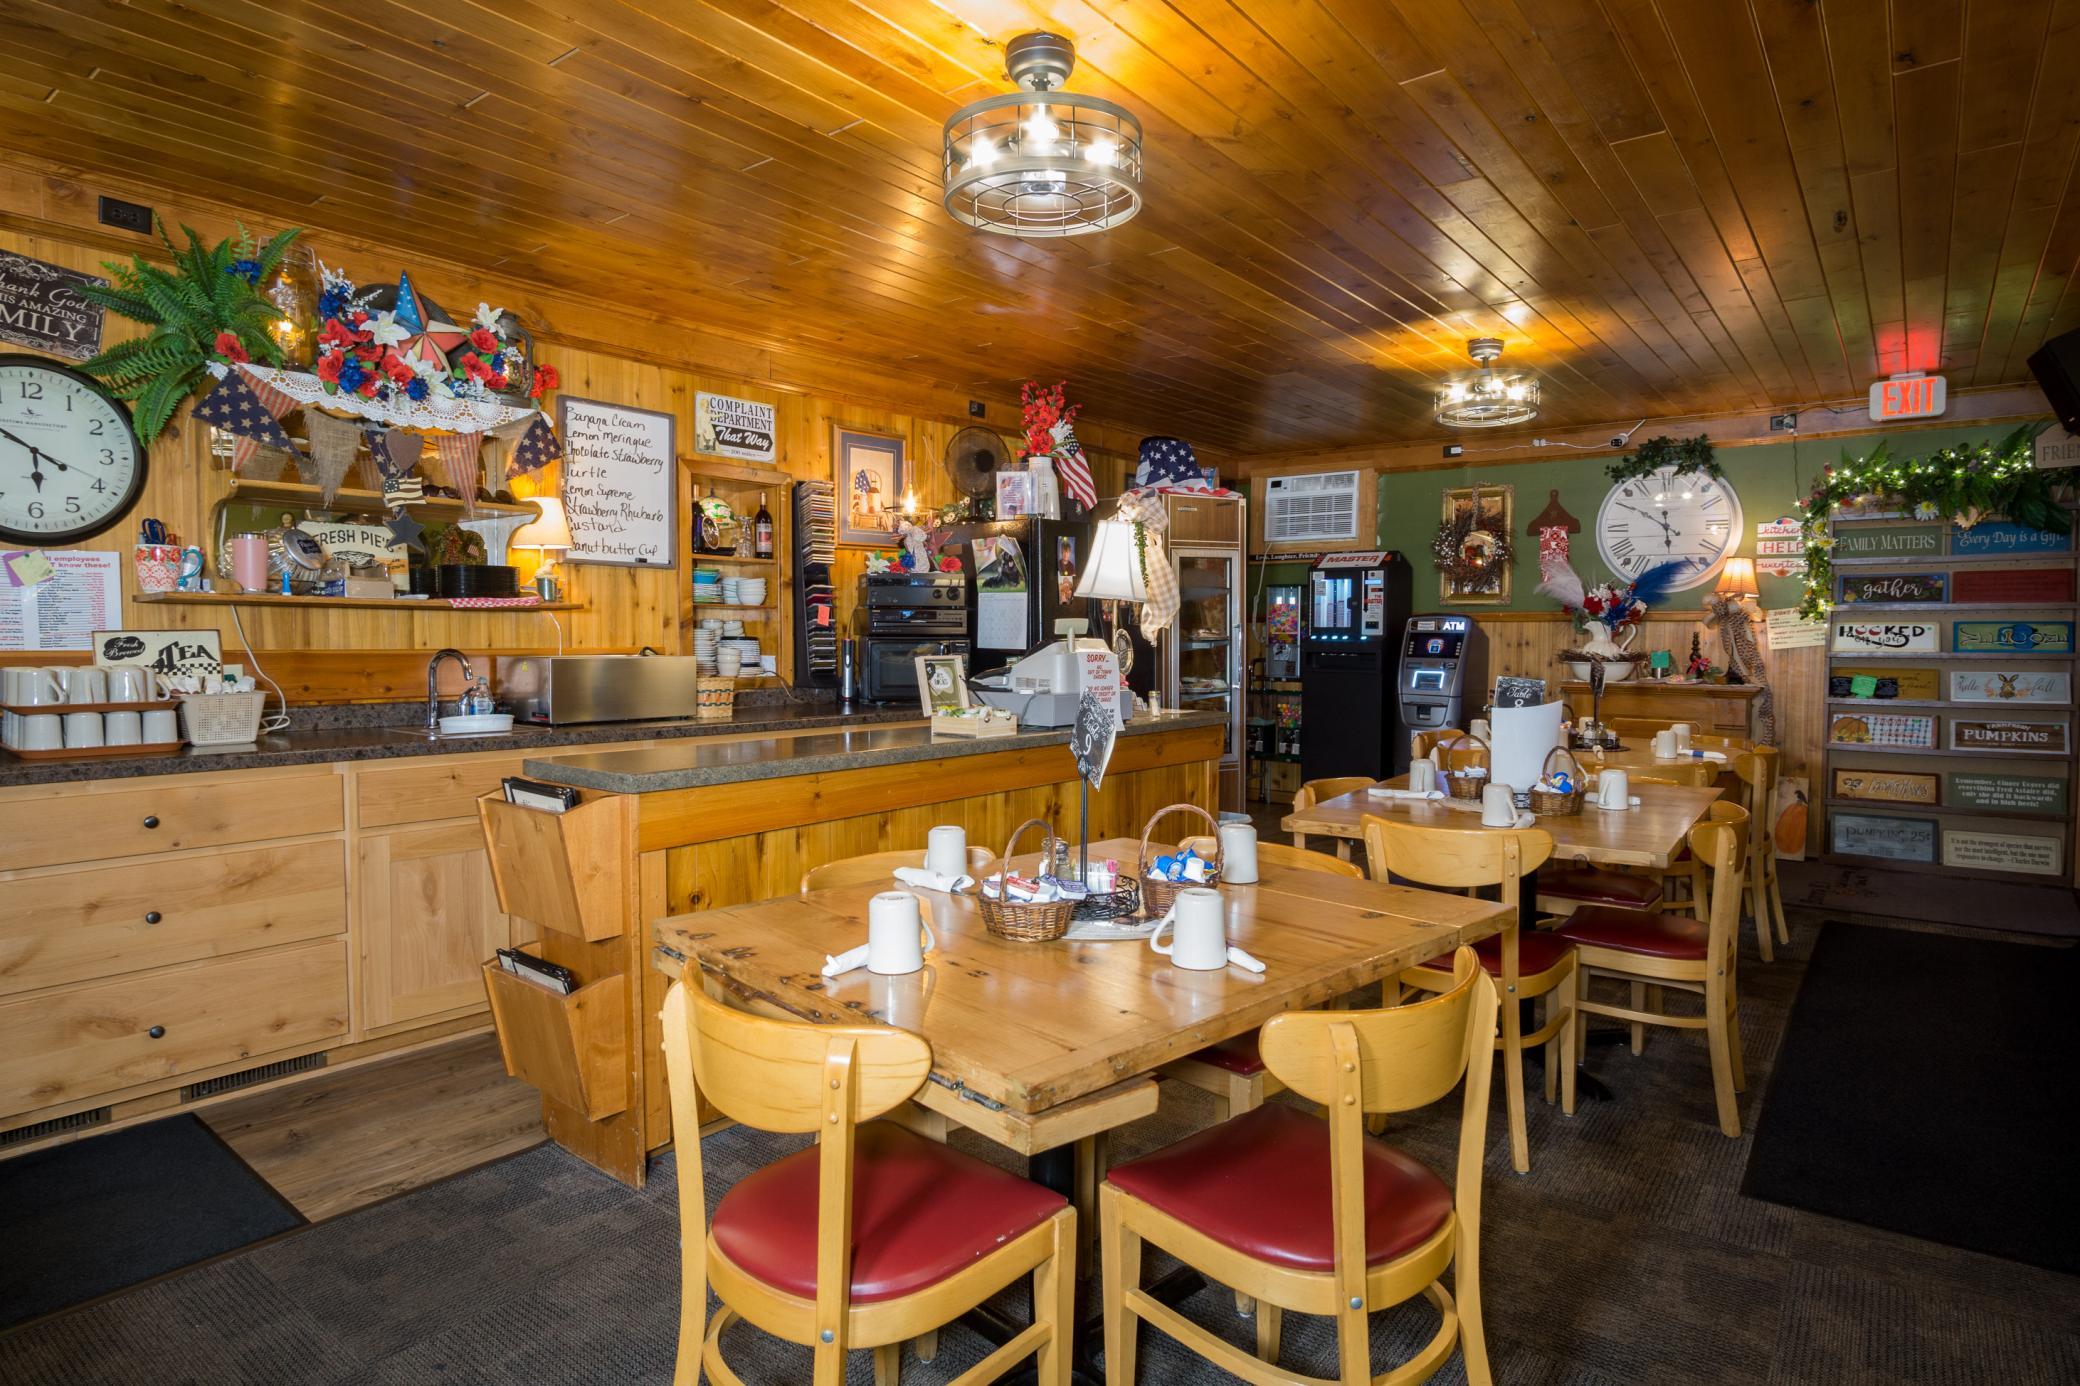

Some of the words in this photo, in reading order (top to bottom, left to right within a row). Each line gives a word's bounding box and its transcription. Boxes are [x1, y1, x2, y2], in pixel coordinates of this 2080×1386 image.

[49, 288, 90, 310] God
[18, 299, 88, 324] AMAZING
[21, 382, 44, 400] 12
[1880, 378, 1937, 417] EXIT
[66, 395, 73, 411] 1
[709, 396, 773, 419] COMPLAINT
[566, 406, 609, 431] Banana
[611, 413, 647, 431] Cream
[710, 409, 773, 432] DEPARTMENT
[89, 419, 104, 436] 2
[565, 423, 600, 440] Lemon
[715, 425, 743, 442] That
[744, 431, 770, 451] Way
[99, 449, 115, 466] 3
[565, 440, 610, 464] Chocolate
[611, 448, 664, 475] Strawberry
[565, 462, 608, 479] Turtle
[91, 478, 107, 493] 4
[564, 479, 594, 497] Lemon
[596, 482, 636, 500] Supreme
[28, 502, 45, 519] 6
[65, 497, 81, 513] 5
[565, 496, 618, 521] Strawberry
[620, 502, 664, 522] Rhubarb
[566, 515, 627, 533] Custard
[1762, 525, 1804, 535] kitchen
[1762, 541, 1805, 554] HELP
[1839, 536, 1880, 552] FAMILY
[1880, 534, 1936, 551] MATTERS
[1957, 530, 1990, 549] Every
[1992, 531, 2017, 548] Day
[2019, 530, 2028, 542] is
[2030, 532, 2037, 542] a
[637, 543, 658, 556] Cup
[54, 555, 101, 563] employees
[1326, 554, 1380, 564] MASTER
[1862, 578, 1924, 600] gather
[1442, 621, 1466, 631] ATM
[1838, 625, 1926, 638] HOOKED
[114, 636, 140, 648] Fresh
[105, 645, 146, 659] Brewed
[151, 640, 218, 674] TEA
[1506, 686, 1533, 699] Table
[1962, 728, 2049, 743] PUMPKINS
[1083, 733, 1092, 756] 9
